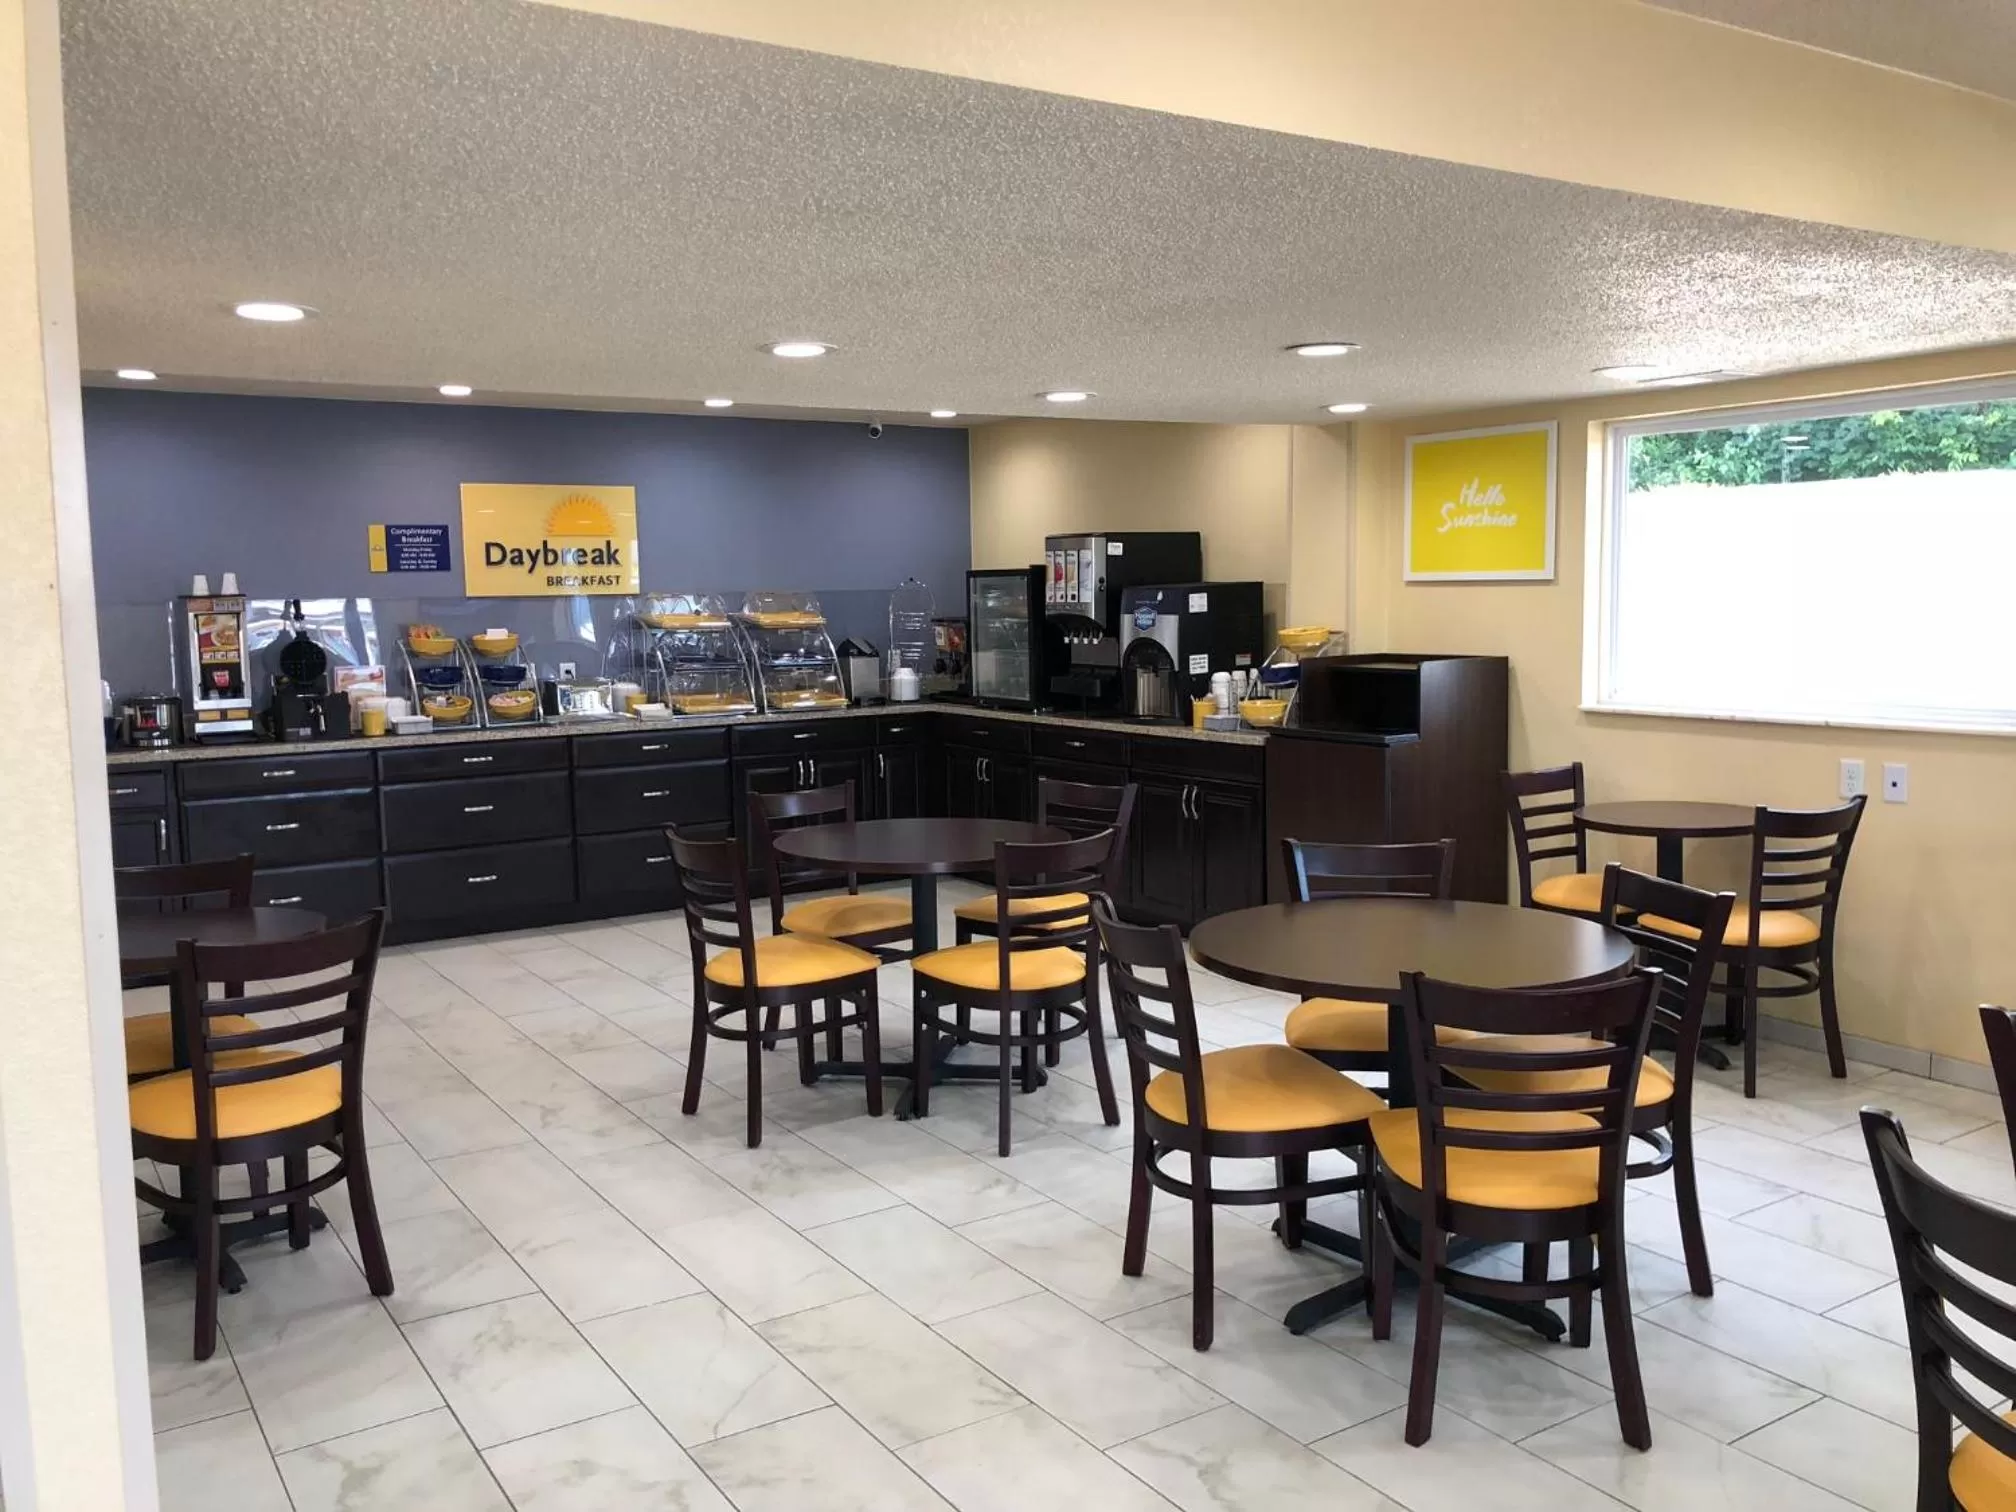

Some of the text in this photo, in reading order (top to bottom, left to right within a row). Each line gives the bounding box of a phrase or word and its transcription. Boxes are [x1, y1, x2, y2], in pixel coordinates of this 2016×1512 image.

[1460, 478, 1506, 507] Hello
[390, 527, 442, 536] Complimentary
[1437, 502, 1517, 534] Sunshine
[485, 539, 620, 574] Daybreak
[547, 575, 621, 587] BREAKFAST
